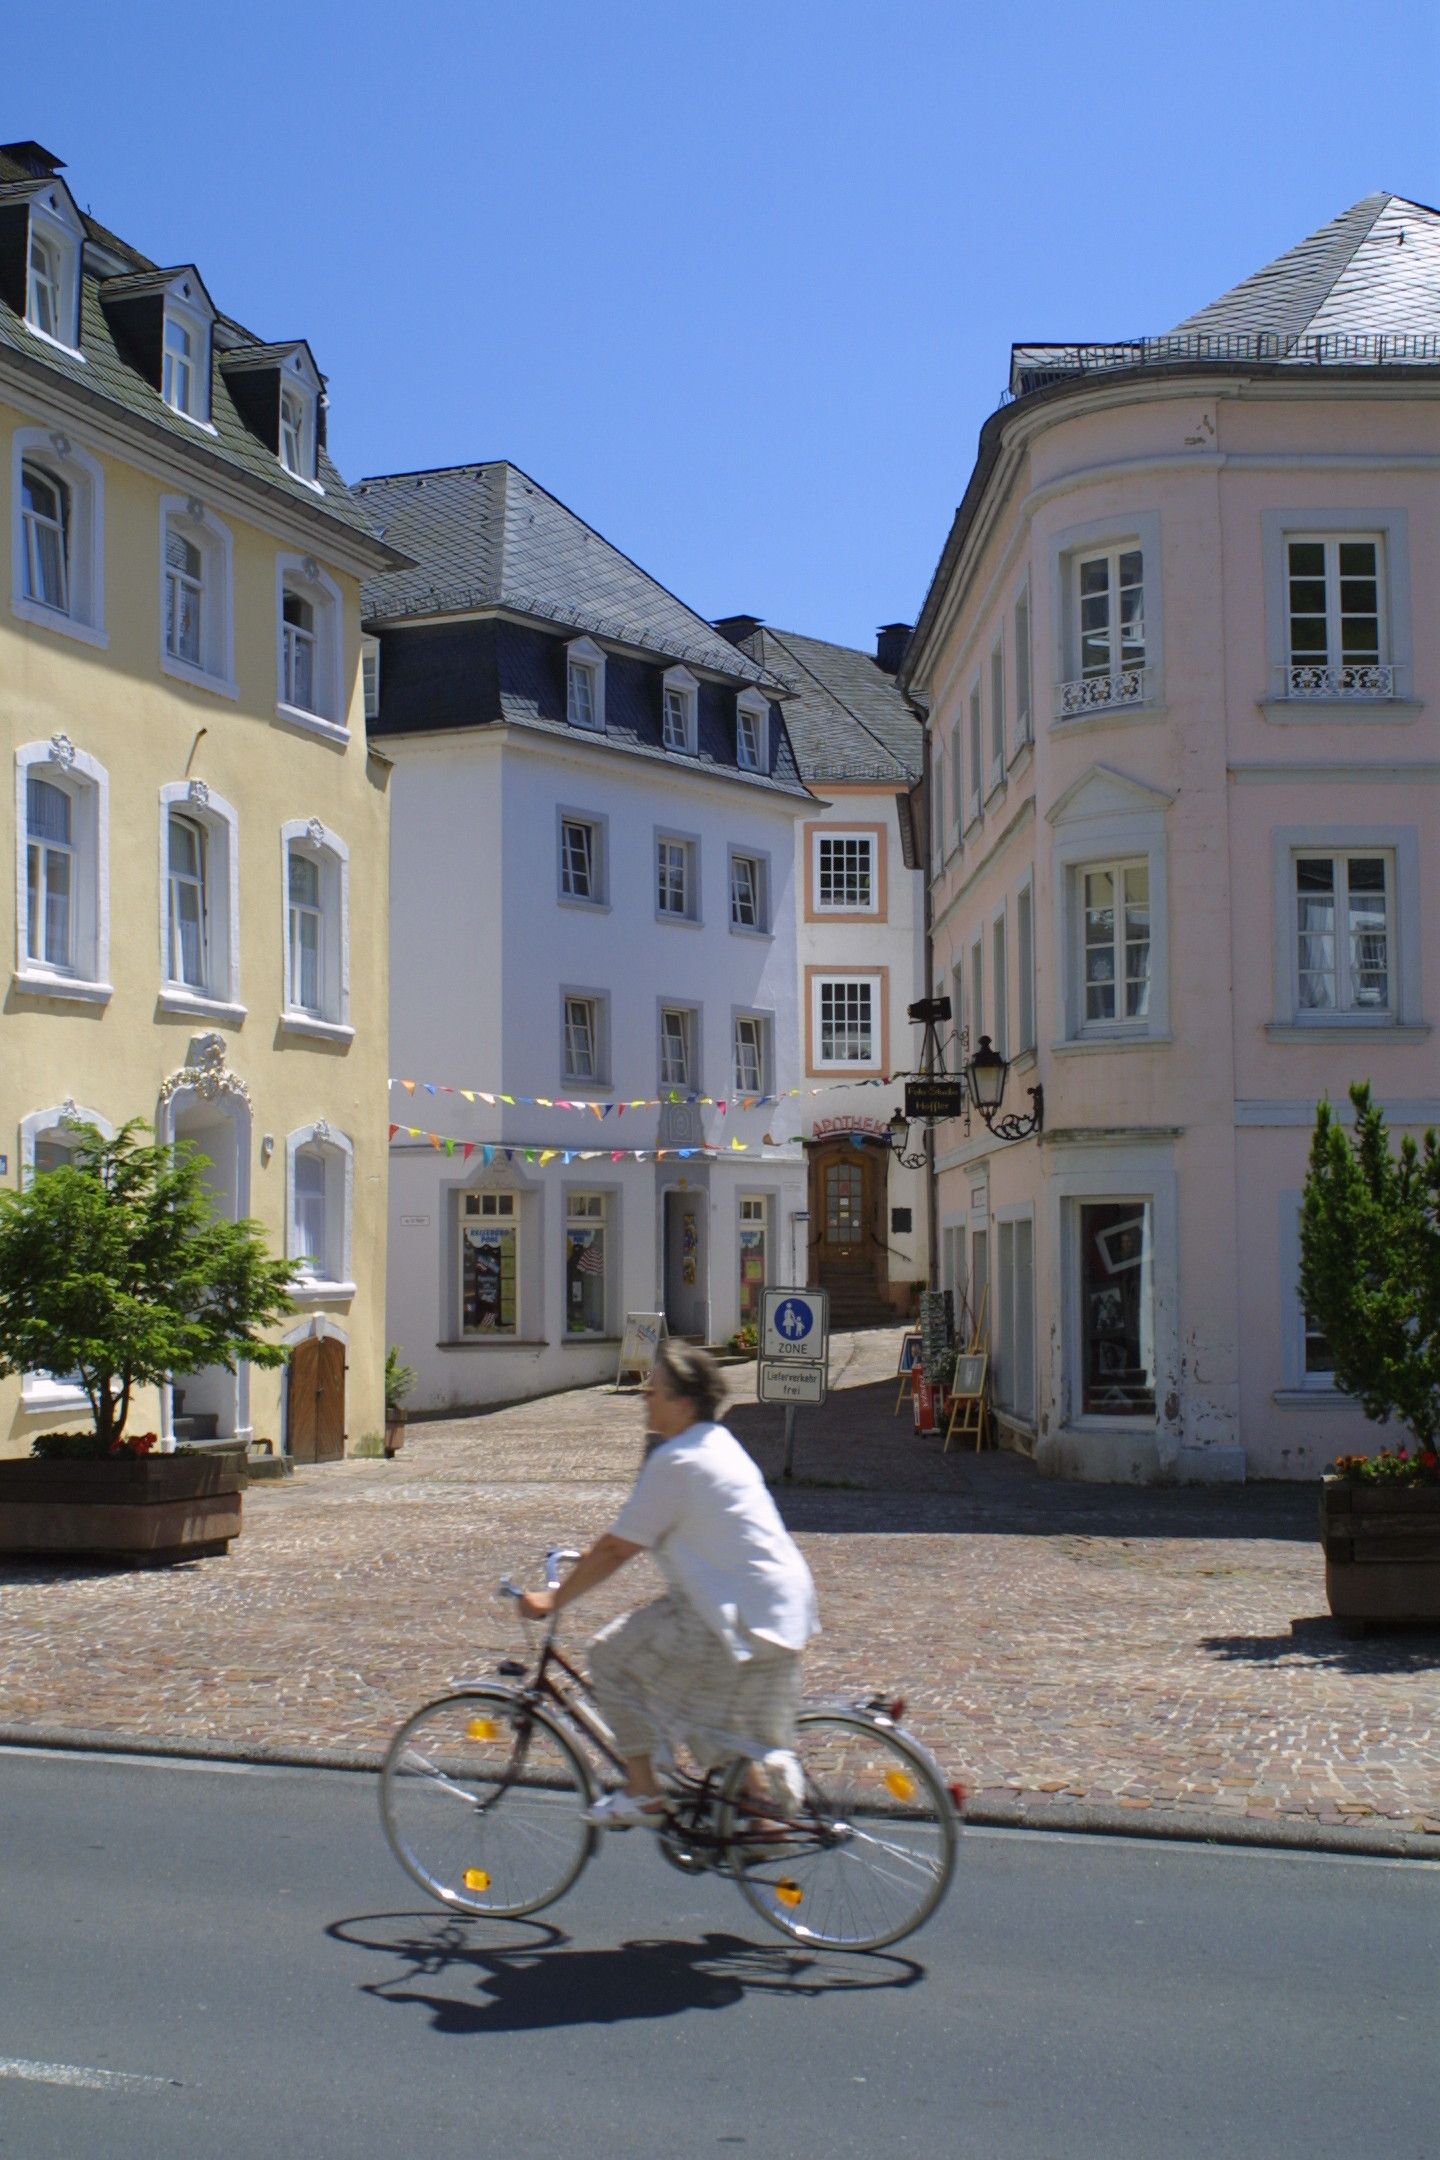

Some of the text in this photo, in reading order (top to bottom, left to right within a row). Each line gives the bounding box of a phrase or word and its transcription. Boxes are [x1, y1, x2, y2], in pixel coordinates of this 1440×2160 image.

[812, 1115, 887, 1137] APOTHEK
[778, 1343, 808, 1354] ZONE
[767, 1371, 817, 1383] Lieferverkehr
[783, 1385, 800, 1395] frei
